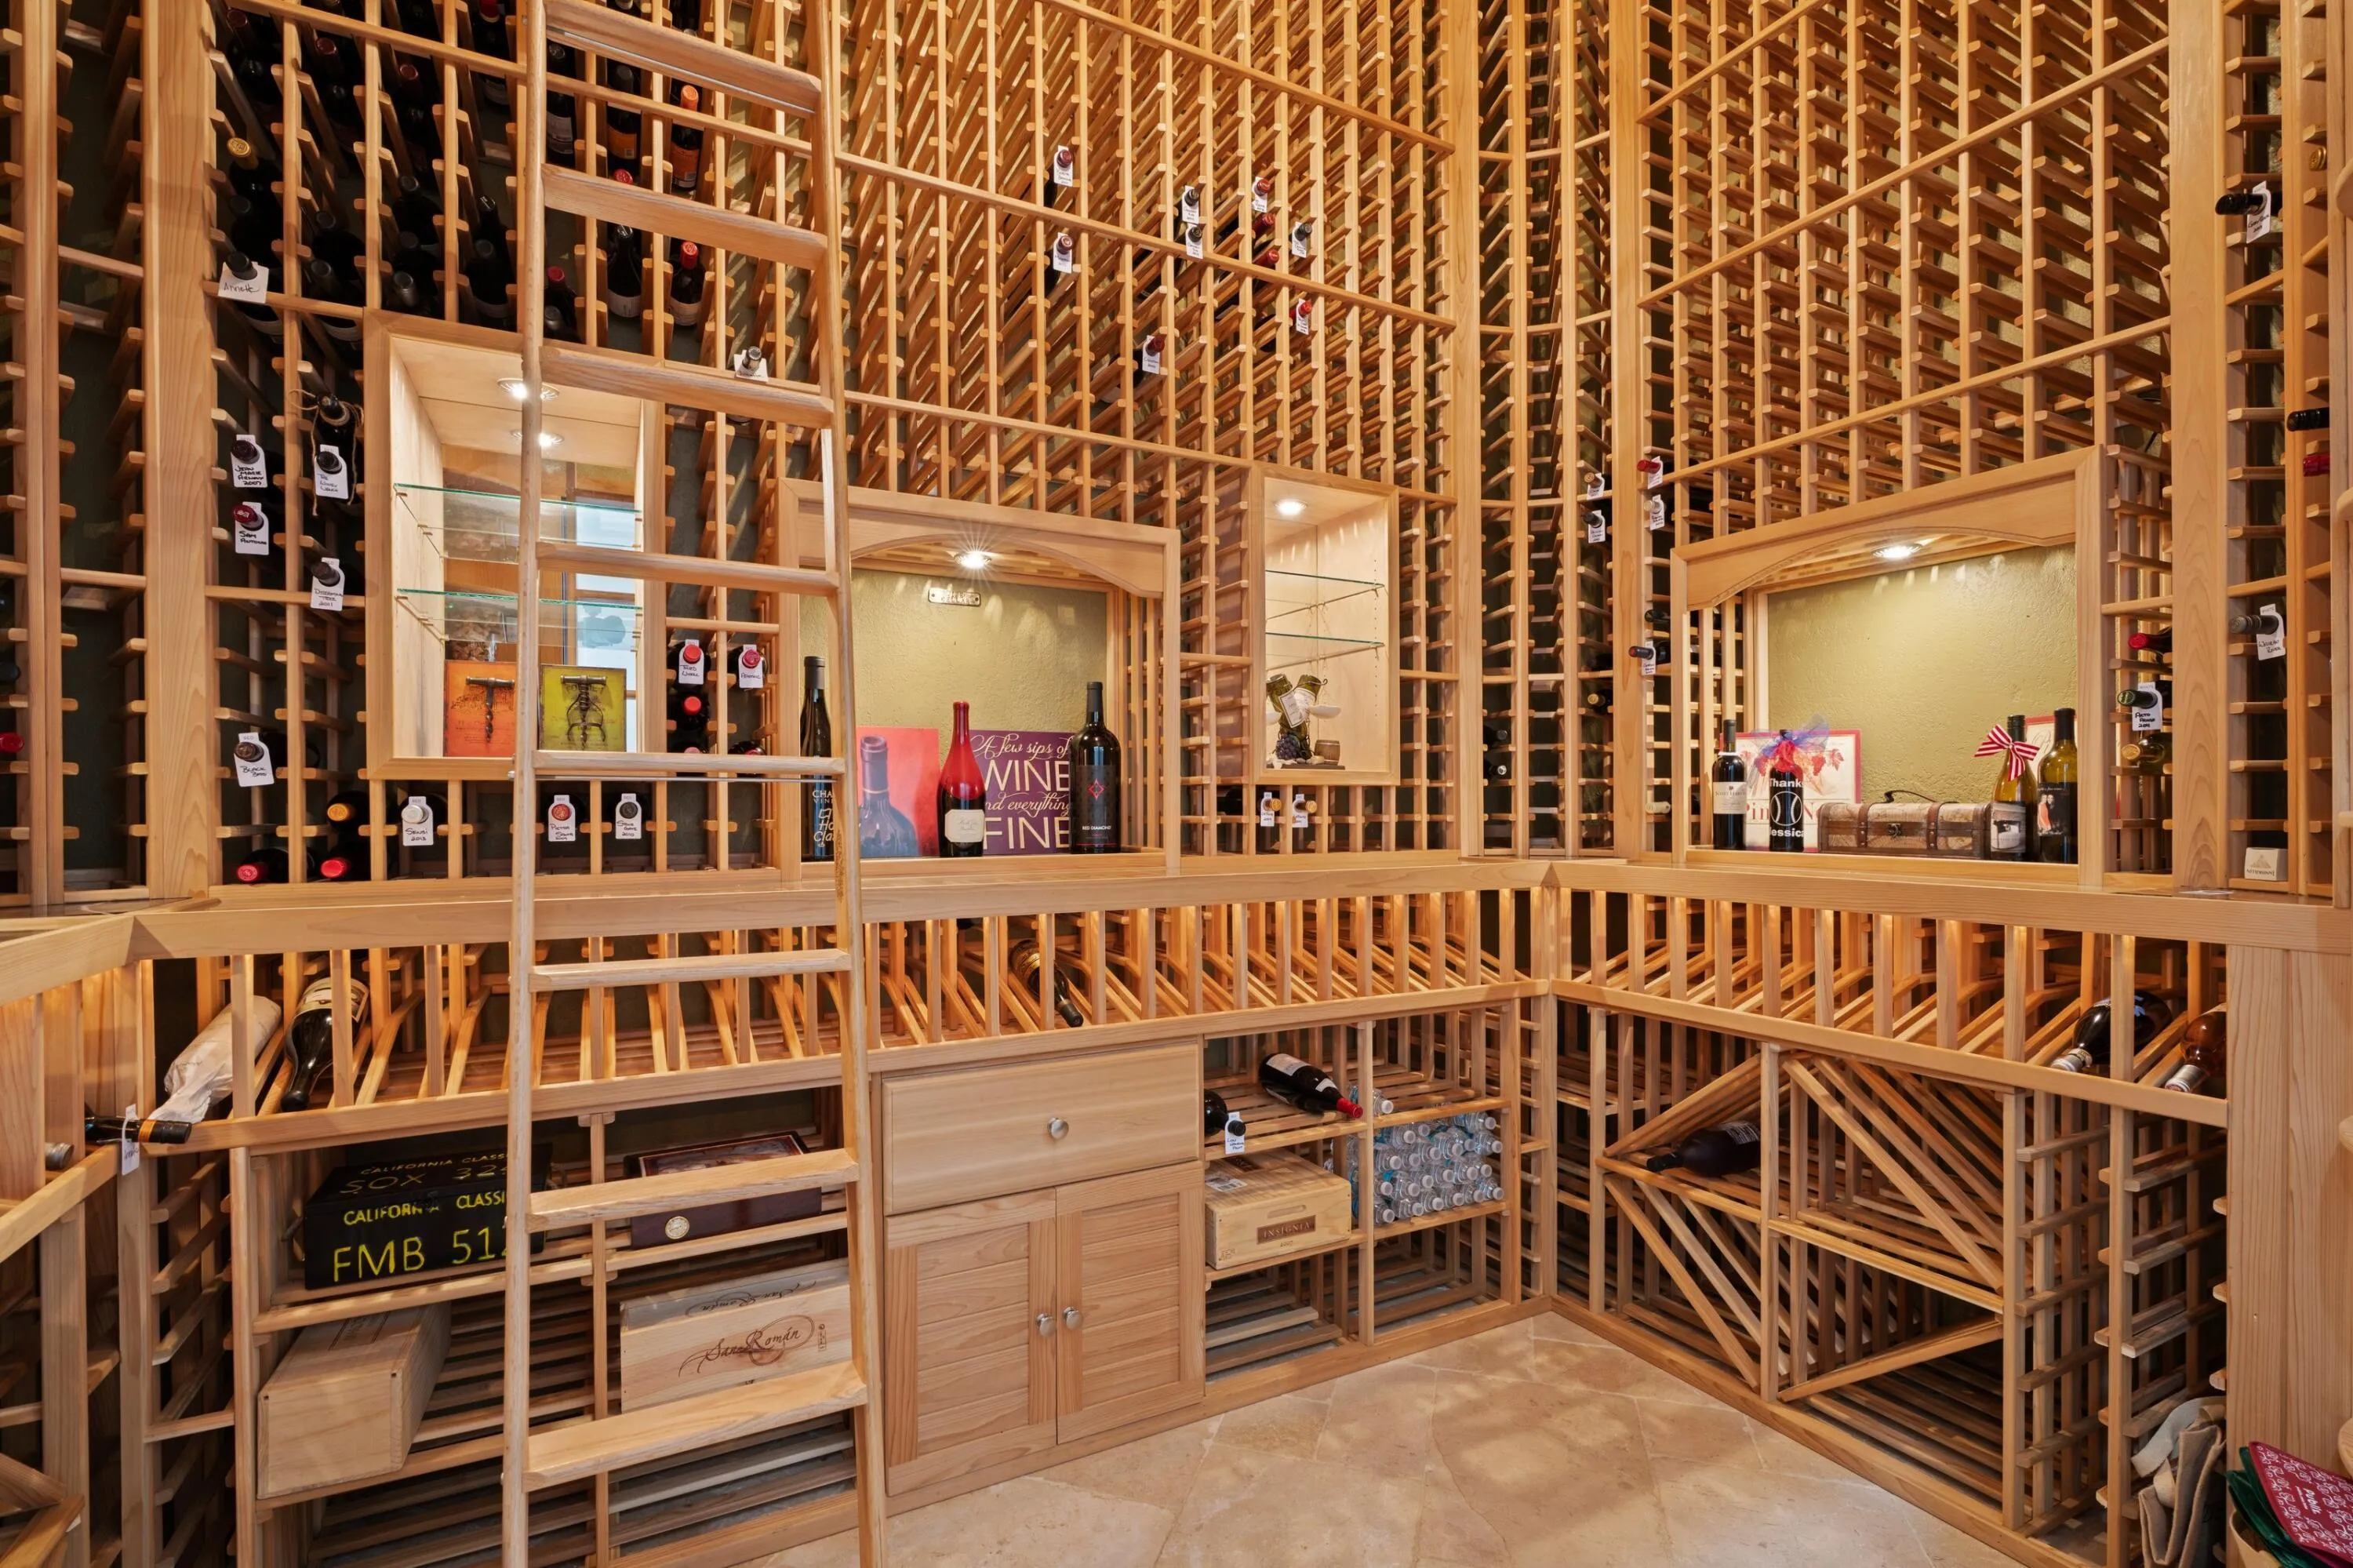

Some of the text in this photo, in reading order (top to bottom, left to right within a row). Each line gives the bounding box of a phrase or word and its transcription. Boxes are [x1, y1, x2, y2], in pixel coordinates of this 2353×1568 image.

[972, 733, 1073, 761] A few sips of
[985, 759, 1070, 792] WINE
[1769, 777, 1804, 788] Thank
[814, 831, 835, 842] Cla
[983, 817, 1070, 850] FINE
[1770, 828, 1805, 837] essica
[363, 1153, 508, 1175] CALIFORNIA CLASS
[340, 1172, 430, 1195] SOX
[344, 1202, 441, 1226] CALIFORNIA
[1264, 1221, 1311, 1239] INSIGNIA
[333, 1227, 507, 1283] FMB 51
